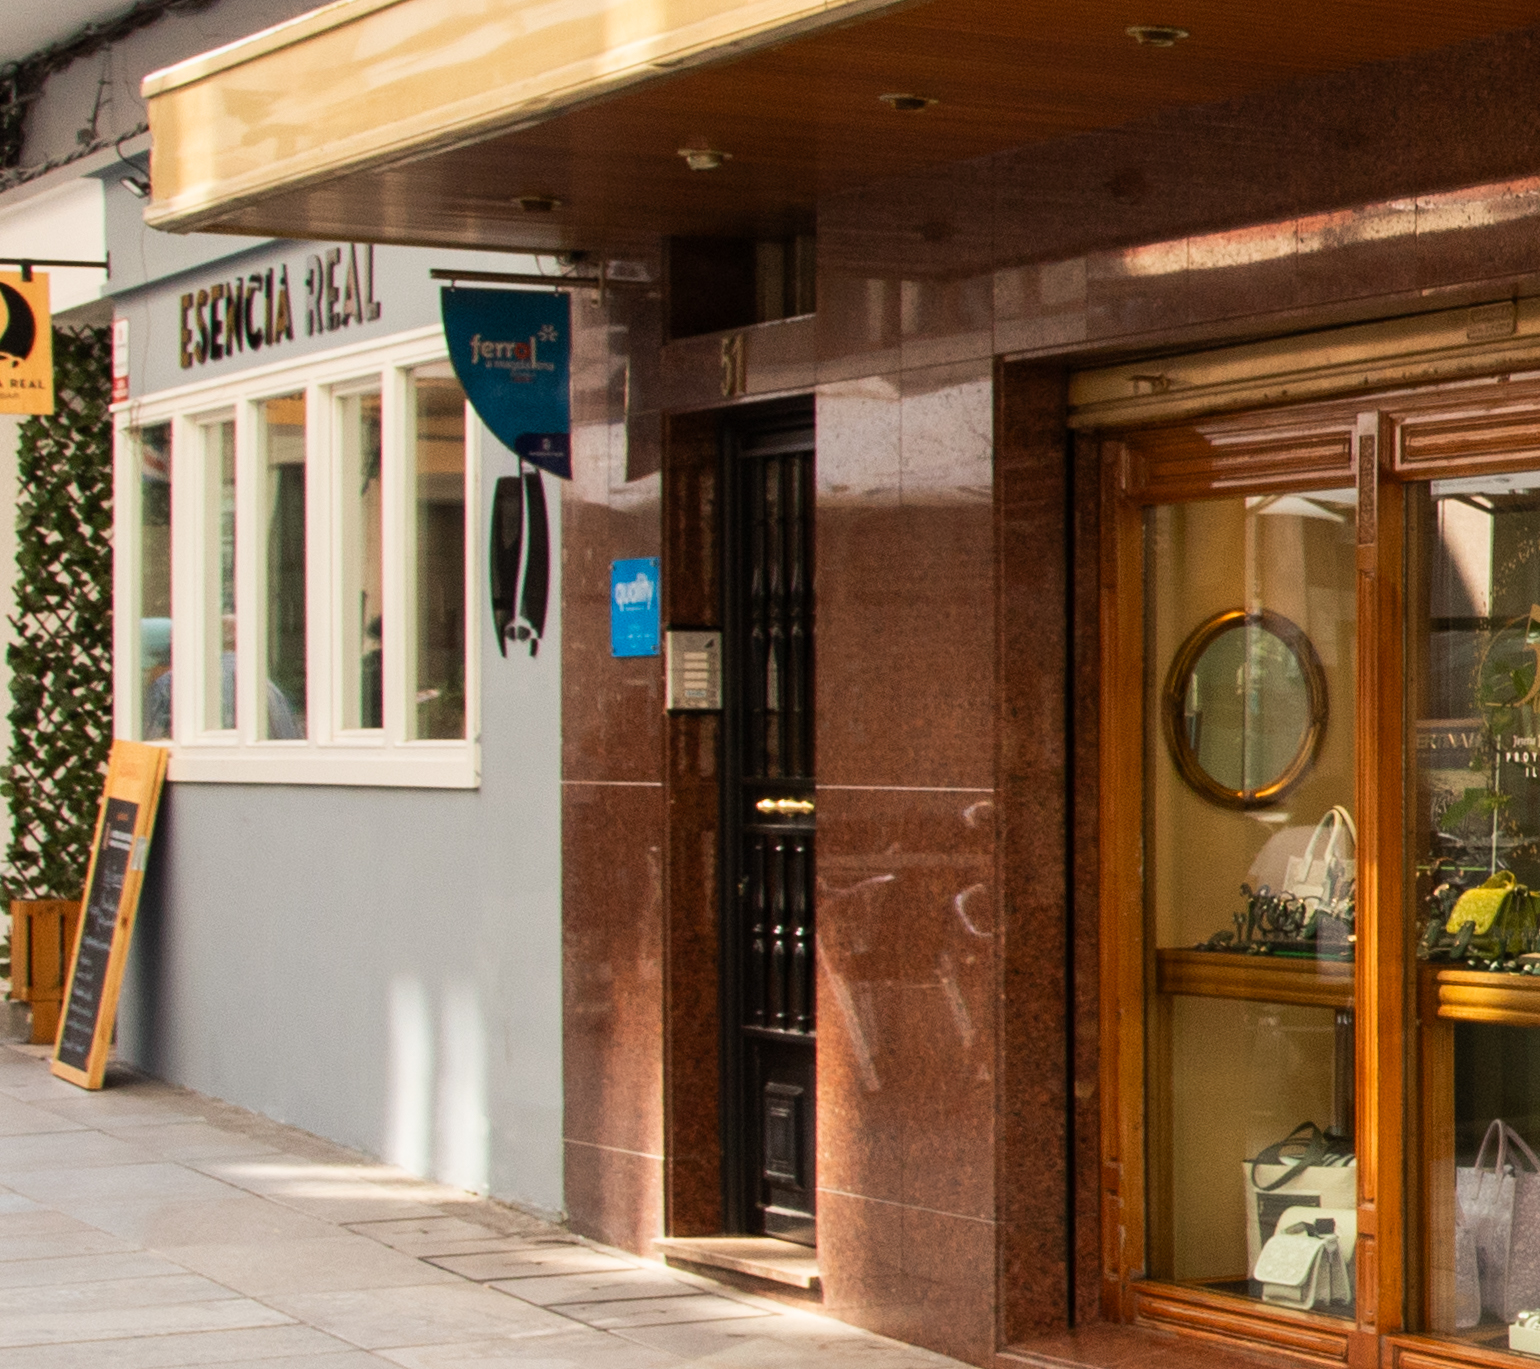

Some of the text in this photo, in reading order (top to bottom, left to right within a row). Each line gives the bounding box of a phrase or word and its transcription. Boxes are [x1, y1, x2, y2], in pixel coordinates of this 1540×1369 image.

[179, 263, 295, 370] ESENCIA
[304, 243, 382, 337] REAL
[470, 333, 537, 366] ferrol
[719, 332, 746, 398] 51
[10, 379, 45, 389] REAL
